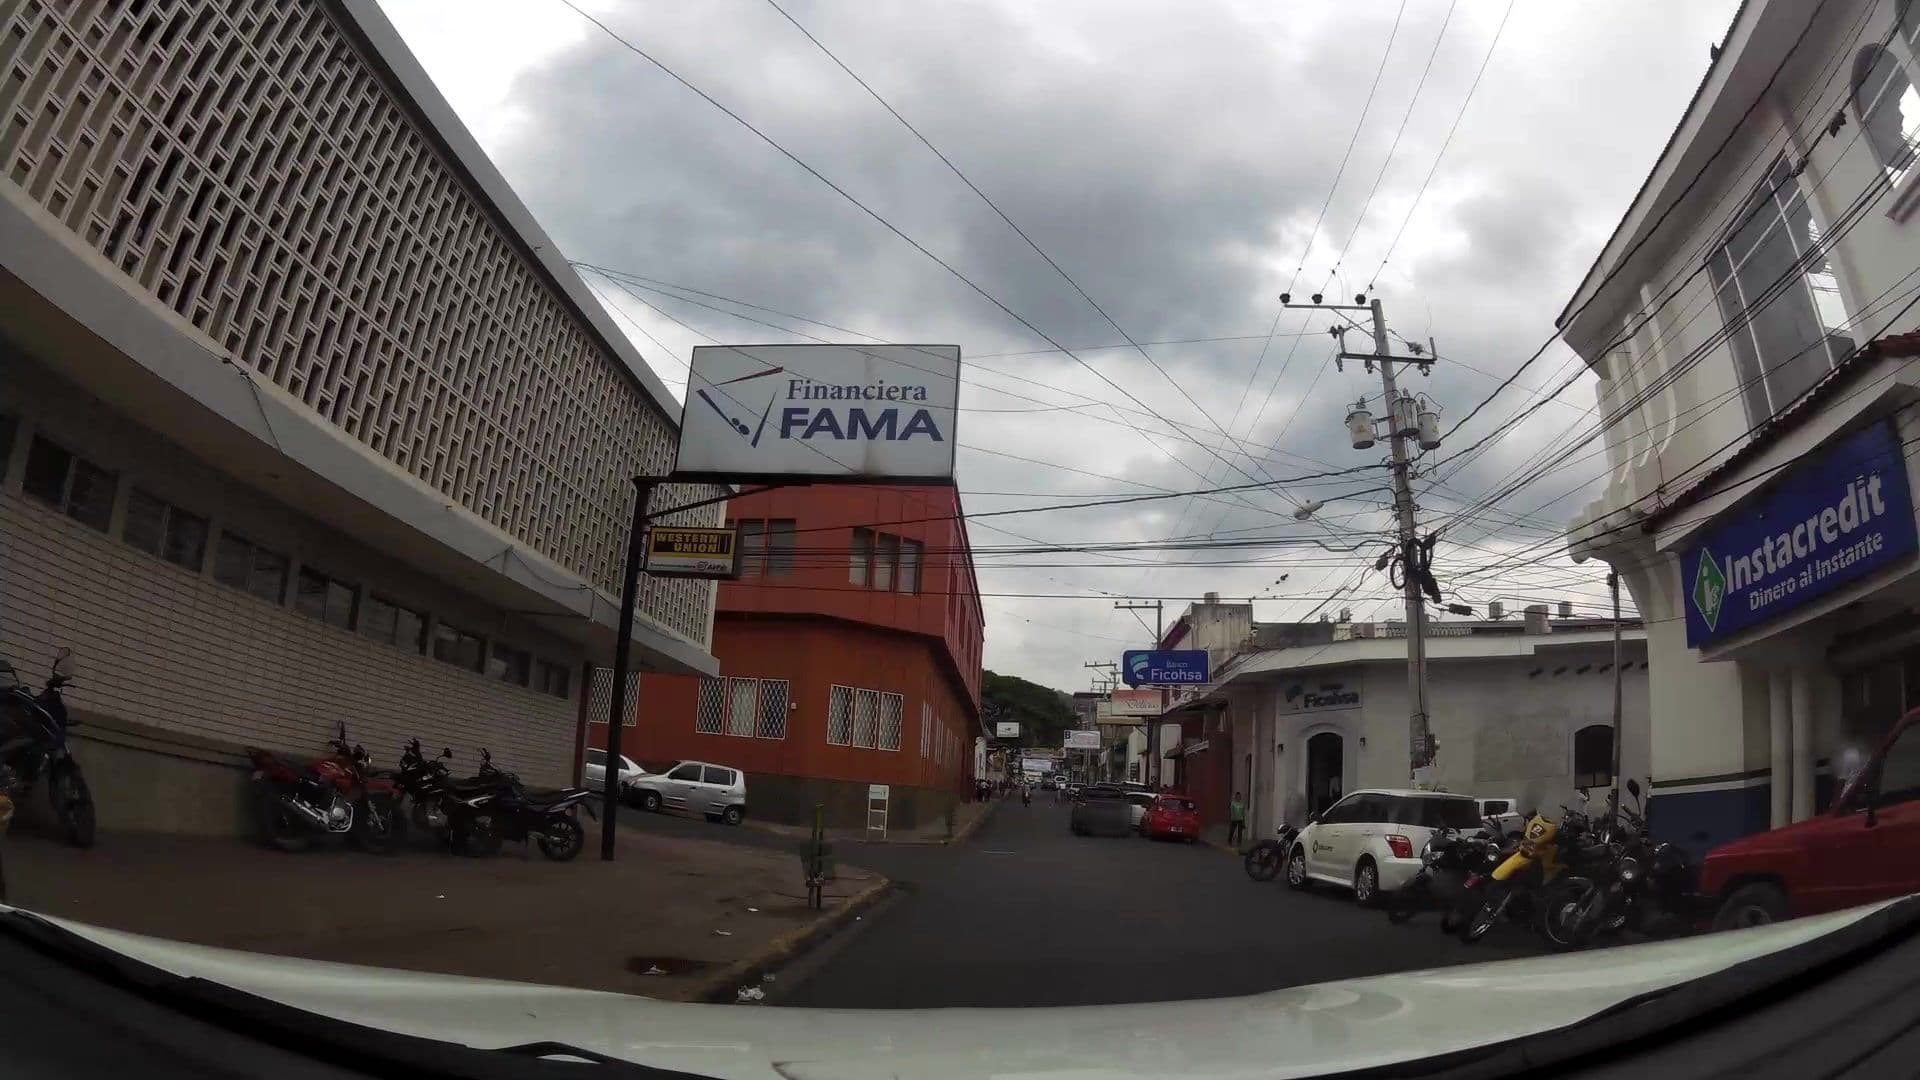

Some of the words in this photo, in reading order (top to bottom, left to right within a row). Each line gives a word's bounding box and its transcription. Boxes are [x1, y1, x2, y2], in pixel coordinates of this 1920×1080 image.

[786, 379, 927, 401] Financiera
[780, 407, 944, 441] FAMA
[656, 533, 718, 543] WESTERN
[1725, 471, 1885, 594] Instacredit
[673, 543, 717, 552] UNION
[1750, 577, 1796, 611] Dinero
[1799, 564, 1813, 589] al
[1816, 532, 1884, 580] Instante
[1166, 660, 1188, 668] Banco
[1151, 668, 1203, 681] Ficohsa
